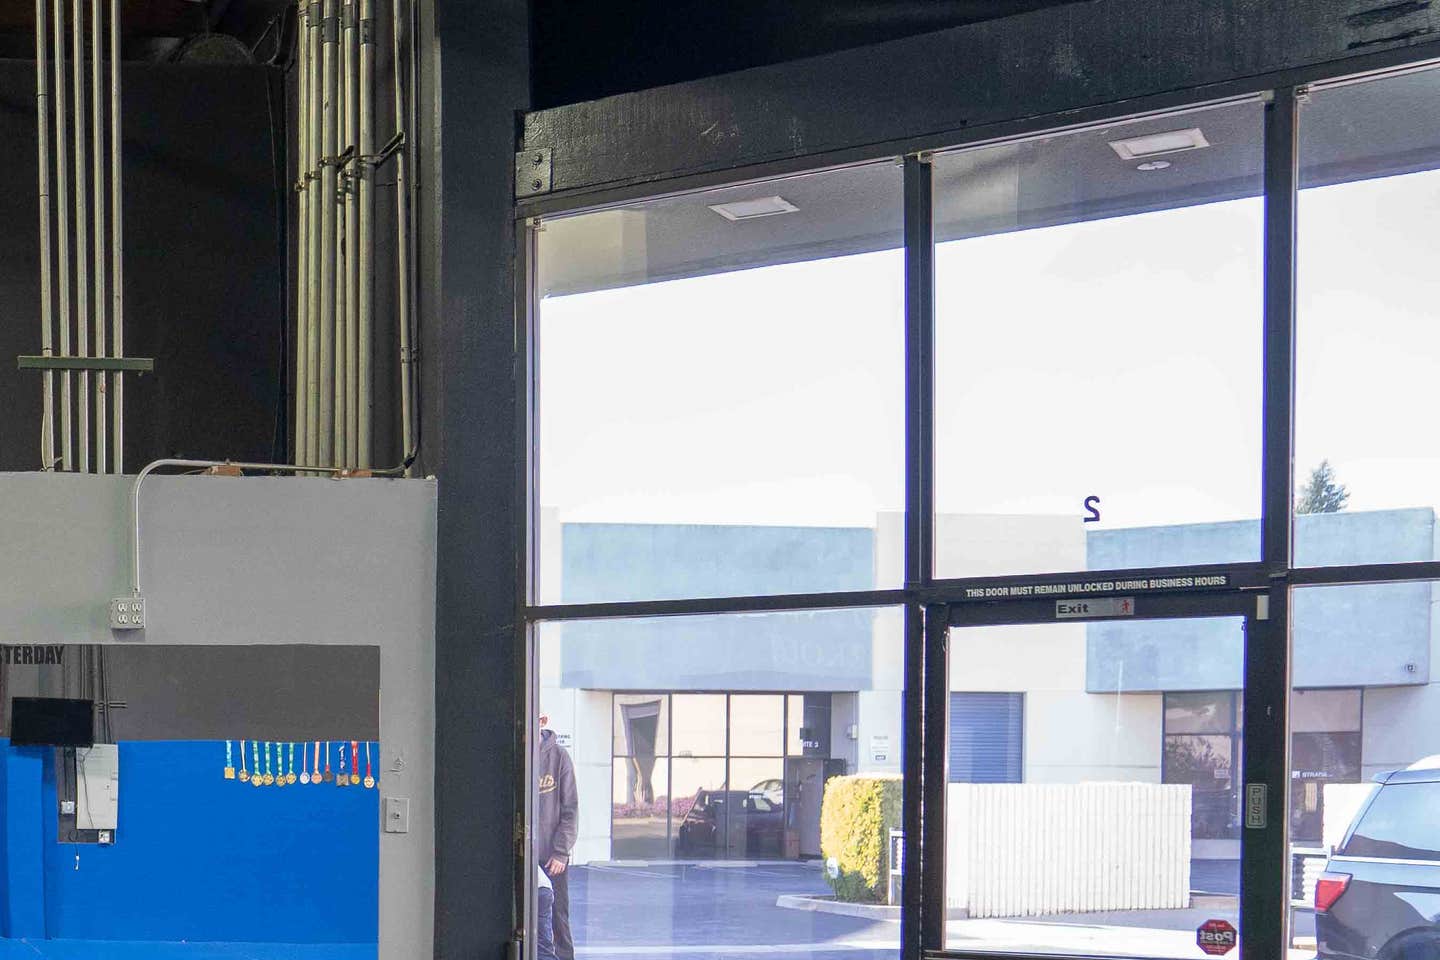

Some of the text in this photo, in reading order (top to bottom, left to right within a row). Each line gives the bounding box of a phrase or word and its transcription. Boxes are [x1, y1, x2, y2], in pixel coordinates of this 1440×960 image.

[966, 576, 1227, 598] THIS DOOR MUST REMAIN UNLOCKED DURING BUSINESS HOURS
[1057, 603, 1089, 614] Exit
[1251, 787, 1261, 824] PUSH
